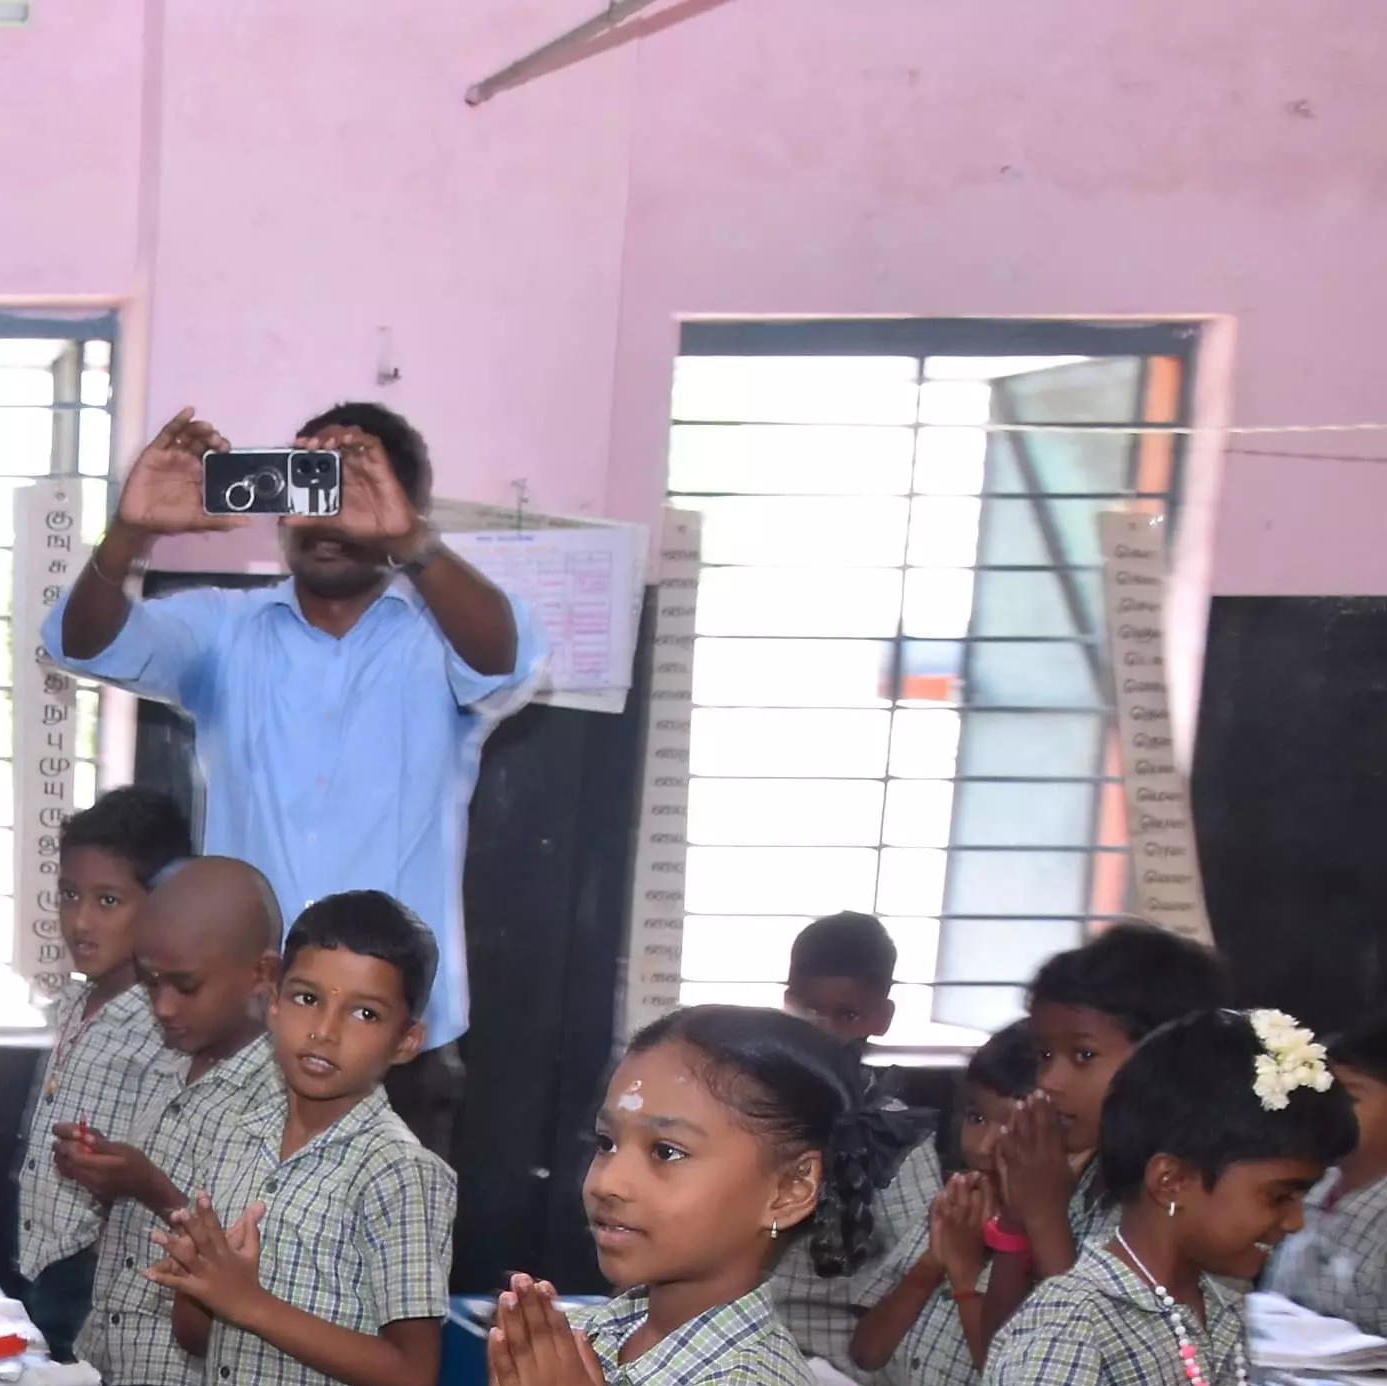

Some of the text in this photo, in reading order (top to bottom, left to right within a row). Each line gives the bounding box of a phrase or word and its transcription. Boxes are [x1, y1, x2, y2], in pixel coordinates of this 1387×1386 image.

[46, 510, 73, 531] கு
[47, 535, 71, 552] ஙு
[43, 704, 67, 725] நு
[40, 757, 70, 777] மு
